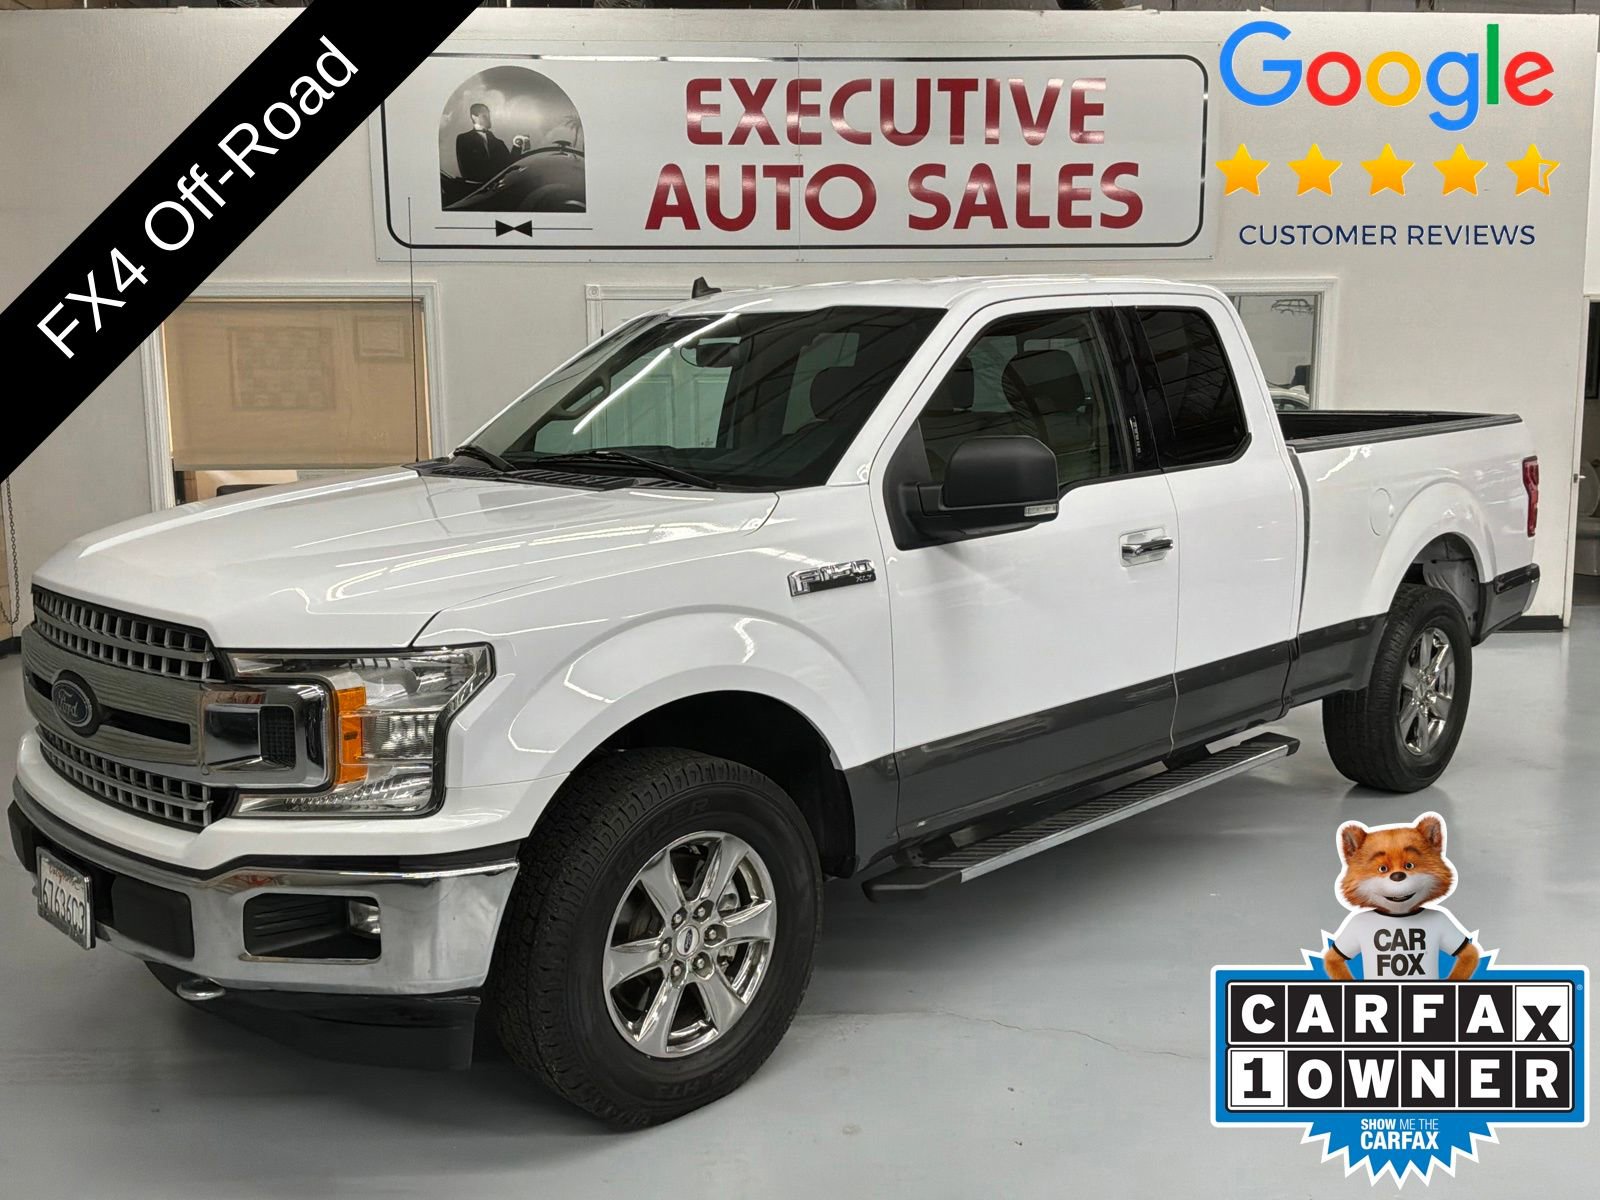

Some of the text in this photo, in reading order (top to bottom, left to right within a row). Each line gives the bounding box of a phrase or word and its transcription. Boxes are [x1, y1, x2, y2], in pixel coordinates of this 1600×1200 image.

[687, 78, 1106, 146] EXECUTIVE
[645, 162, 1143, 231] AUTO SALES
